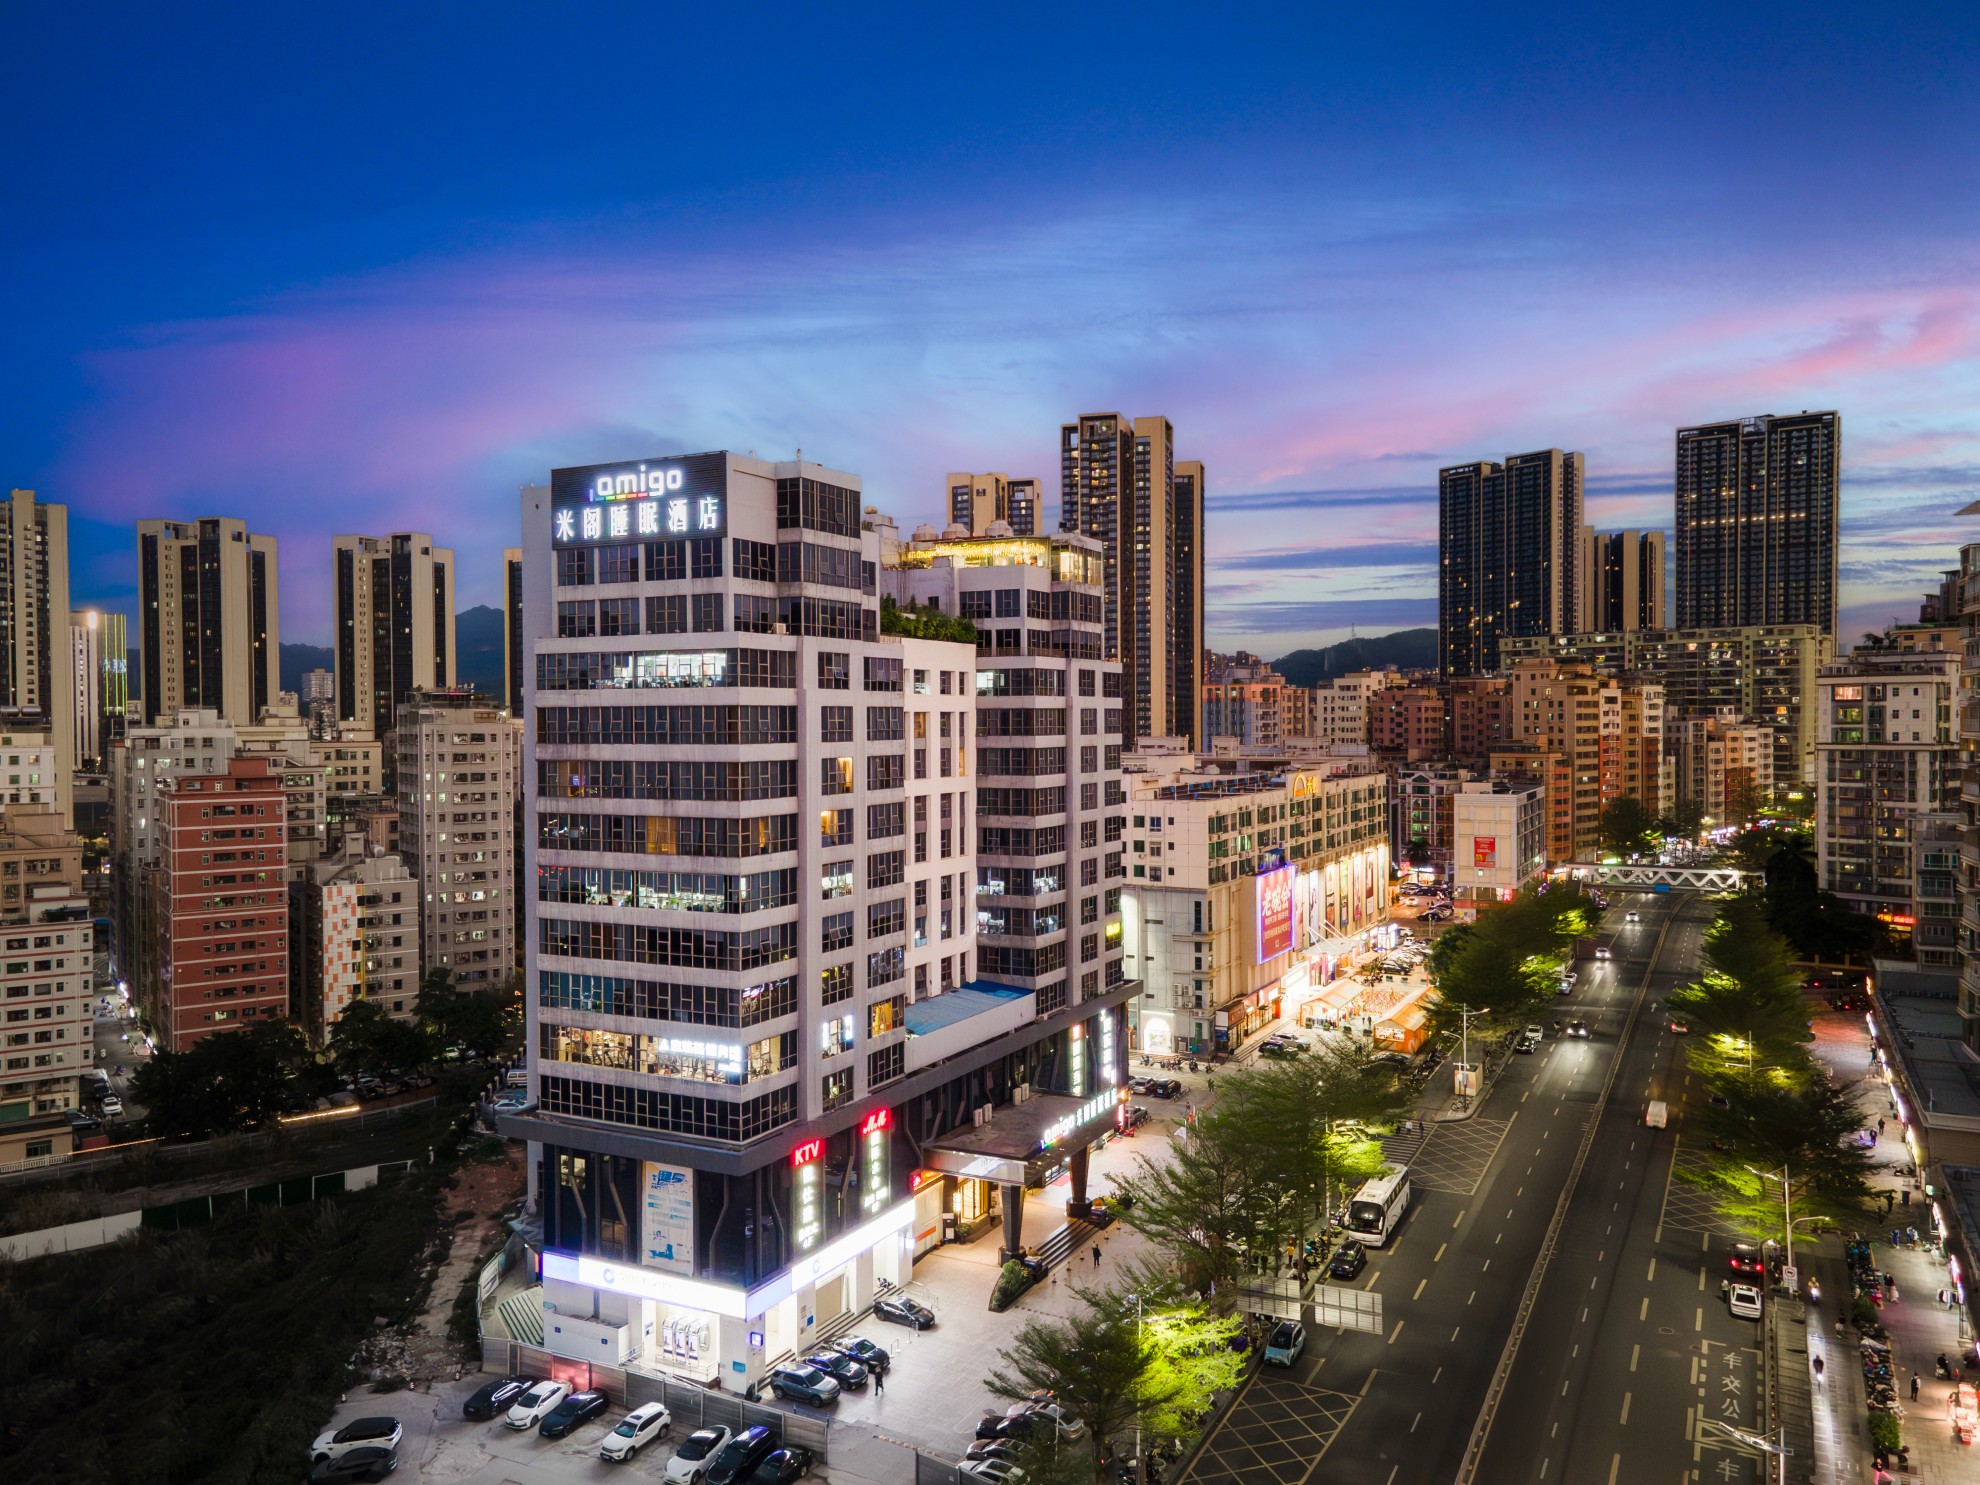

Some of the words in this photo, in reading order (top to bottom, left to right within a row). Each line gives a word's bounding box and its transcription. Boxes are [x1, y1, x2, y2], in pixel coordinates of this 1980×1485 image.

[597, 465, 682, 497] amigo
[556, 496, 719, 542] 米阁睡眠酒店
[1044, 1115, 1075, 1144] amigo
[795, 1140, 820, 1166] KTV
